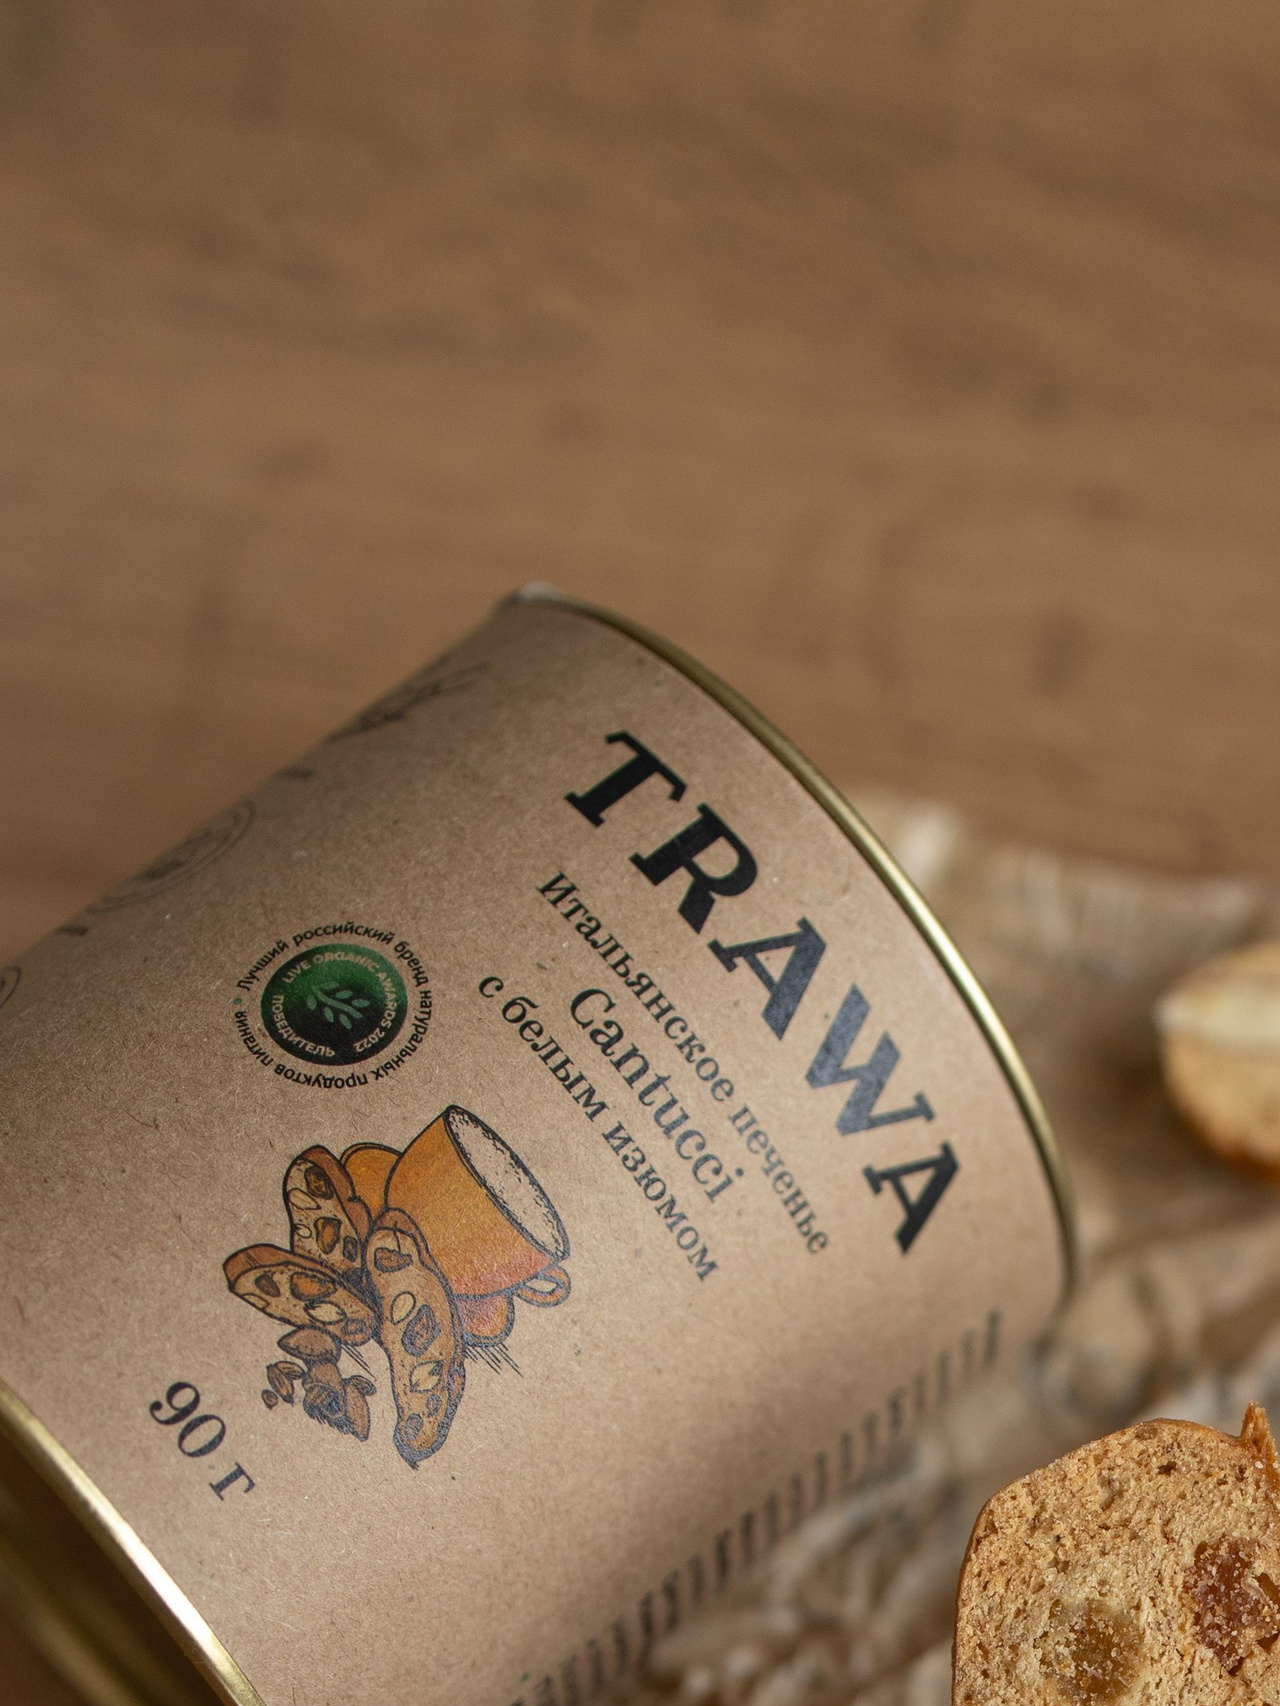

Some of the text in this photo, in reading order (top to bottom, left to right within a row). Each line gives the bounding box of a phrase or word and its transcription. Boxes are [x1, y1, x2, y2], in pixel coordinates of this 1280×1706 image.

[234, 921, 432, 1089] Лучший российский бренд натуральных продуктов питания
[271, 993, 336, 1058] ПОБЕДИТЕЛЬ
[281, 951, 398, 1053] LIVE ORGANIC AWARDS 2022
[536, 872, 830, 1254] Итальянское печенье
[564, 730, 959, 1255] TRAWA
[500, 995, 610, 1123] белым
[601, 1121, 720, 1282] изюмом
[569, 988, 745, 1204] Cantucci
[149, 1381, 256, 1501] 90 г
